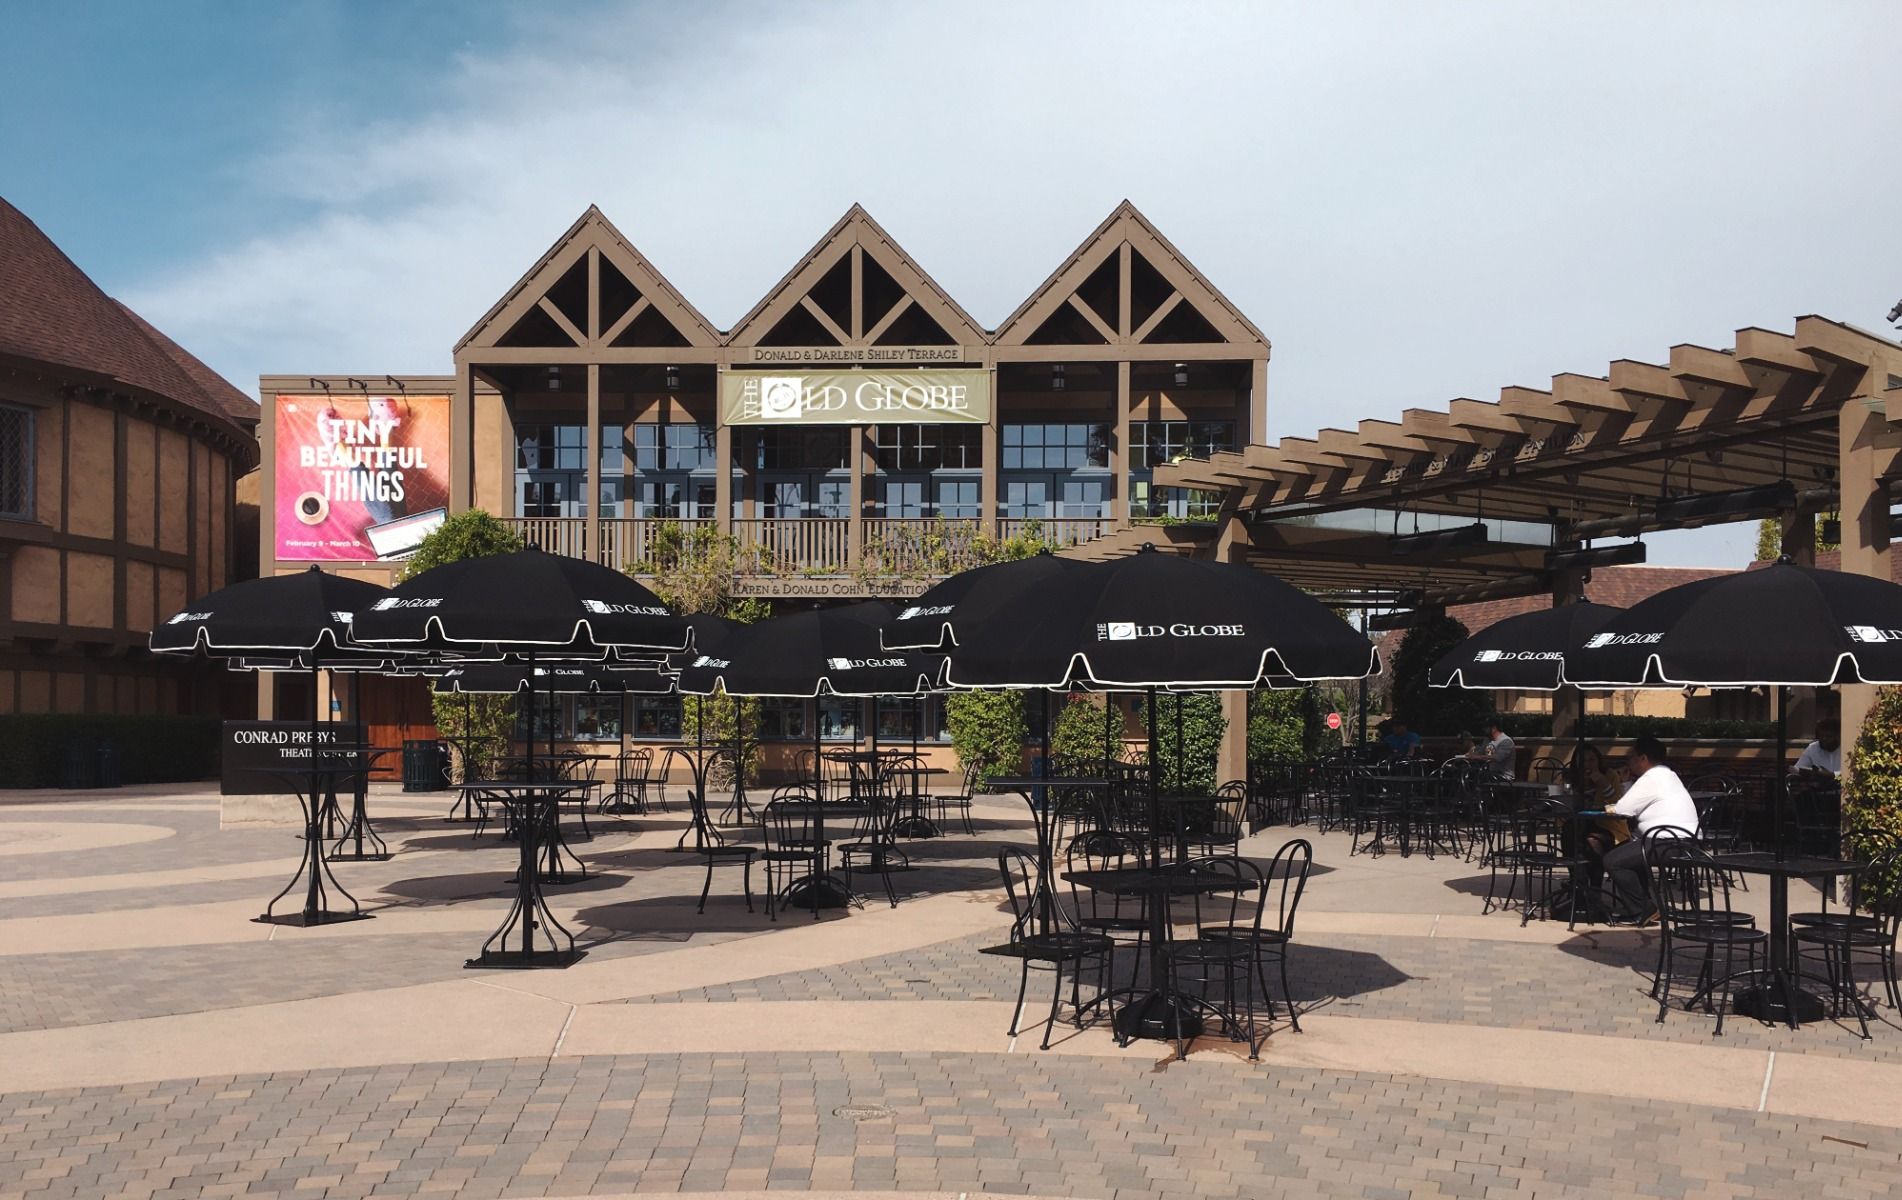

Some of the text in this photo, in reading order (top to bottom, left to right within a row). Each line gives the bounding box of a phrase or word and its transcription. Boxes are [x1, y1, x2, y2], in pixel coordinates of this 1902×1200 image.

[755, 349, 958, 360] DONALD & DARLENE SHILEY TERRACE
[744, 379, 758, 418] THE
[854, 381, 969, 411] GLOBE
[328, 419, 396, 444] TINY
[300, 446, 428, 469] BEAUTIFUL
[321, 470, 405, 502] THINGS
[286, 540, 317, 548] February
[732, 583, 769, 595] KAREN
[772, 585, 780, 595] &
[783, 584, 829, 595] DONALD
[832, 584, 864, 595] COHN
[625, 604, 671, 616] GLOBE
[1096, 623, 1109, 642] THE
[1169, 623, 1246, 637] GLOBE
[866, 658, 907, 667] GLOBE
[1517, 651, 1564, 661] GLOBE
[234, 730, 289, 744] CONRAD
